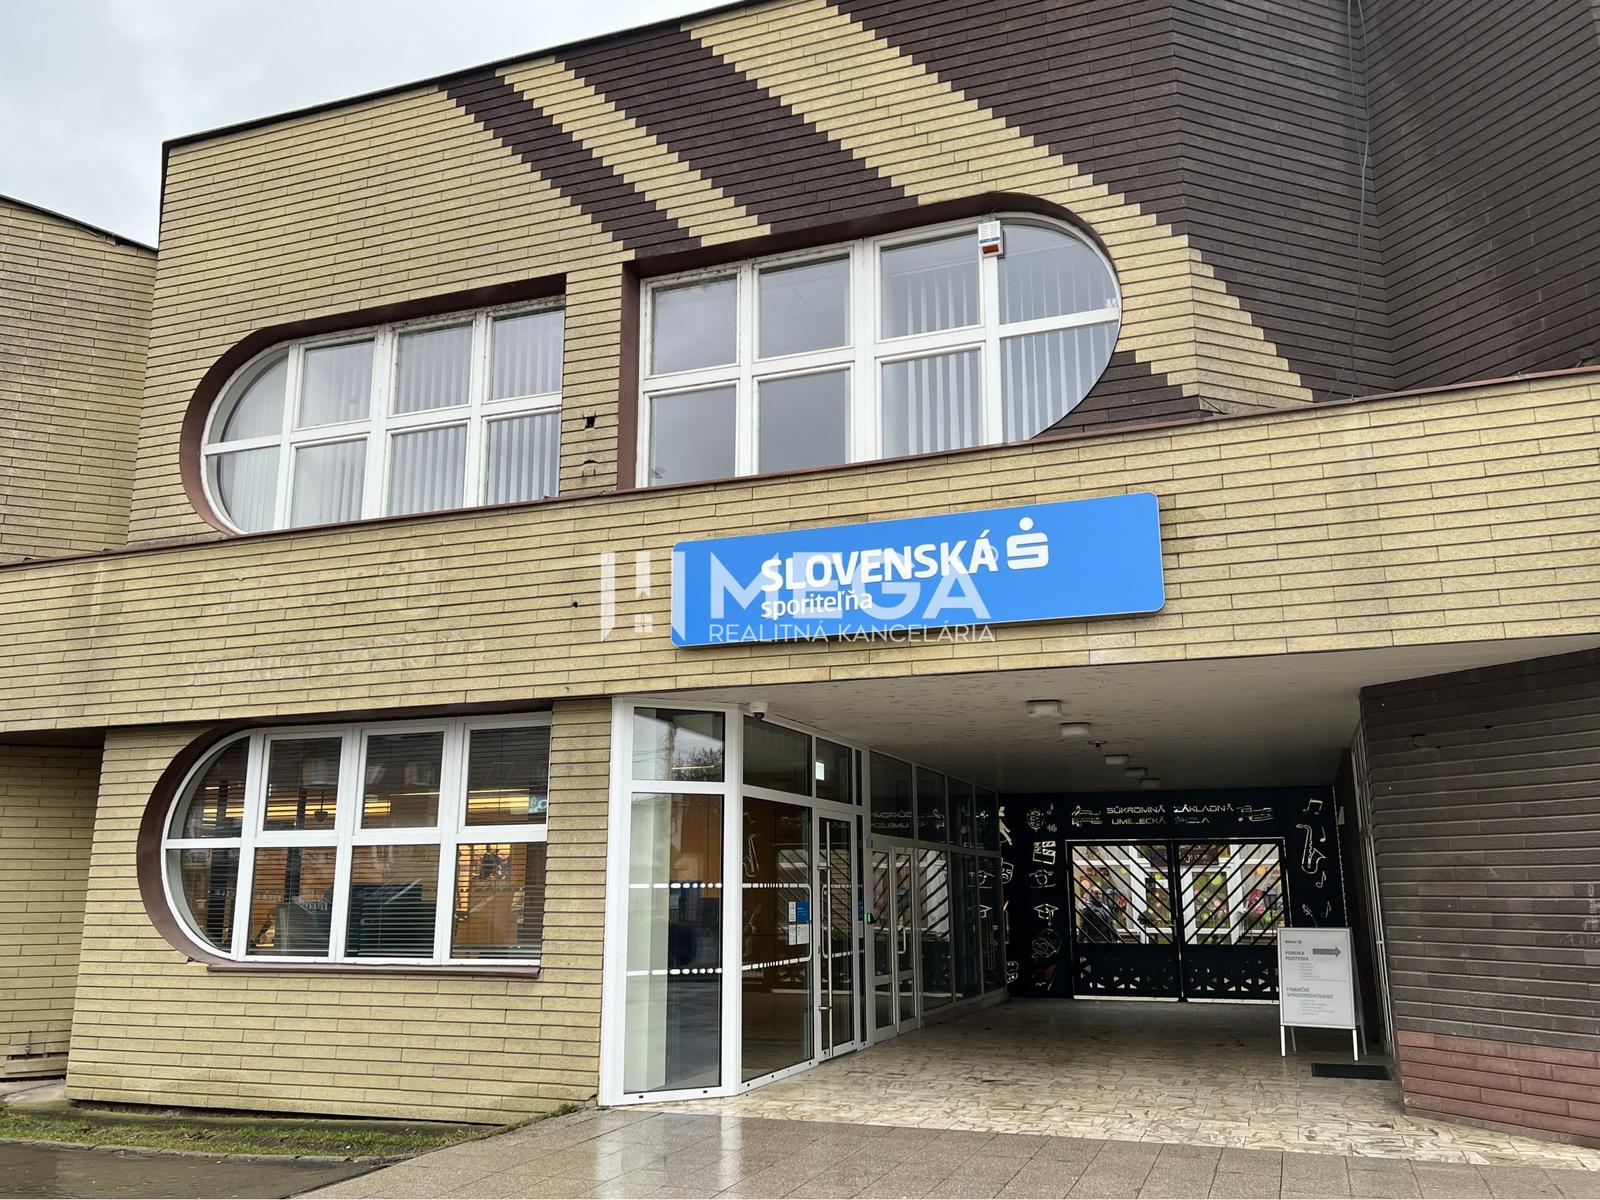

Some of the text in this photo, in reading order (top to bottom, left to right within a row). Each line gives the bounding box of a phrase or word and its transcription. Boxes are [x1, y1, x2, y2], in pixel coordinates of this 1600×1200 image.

[760, 529, 998, 592] SLOVENSKÁ
[761, 589, 873, 621] sporiteľňa
[1106, 804, 1166, 814] SÚKROMNÁ
